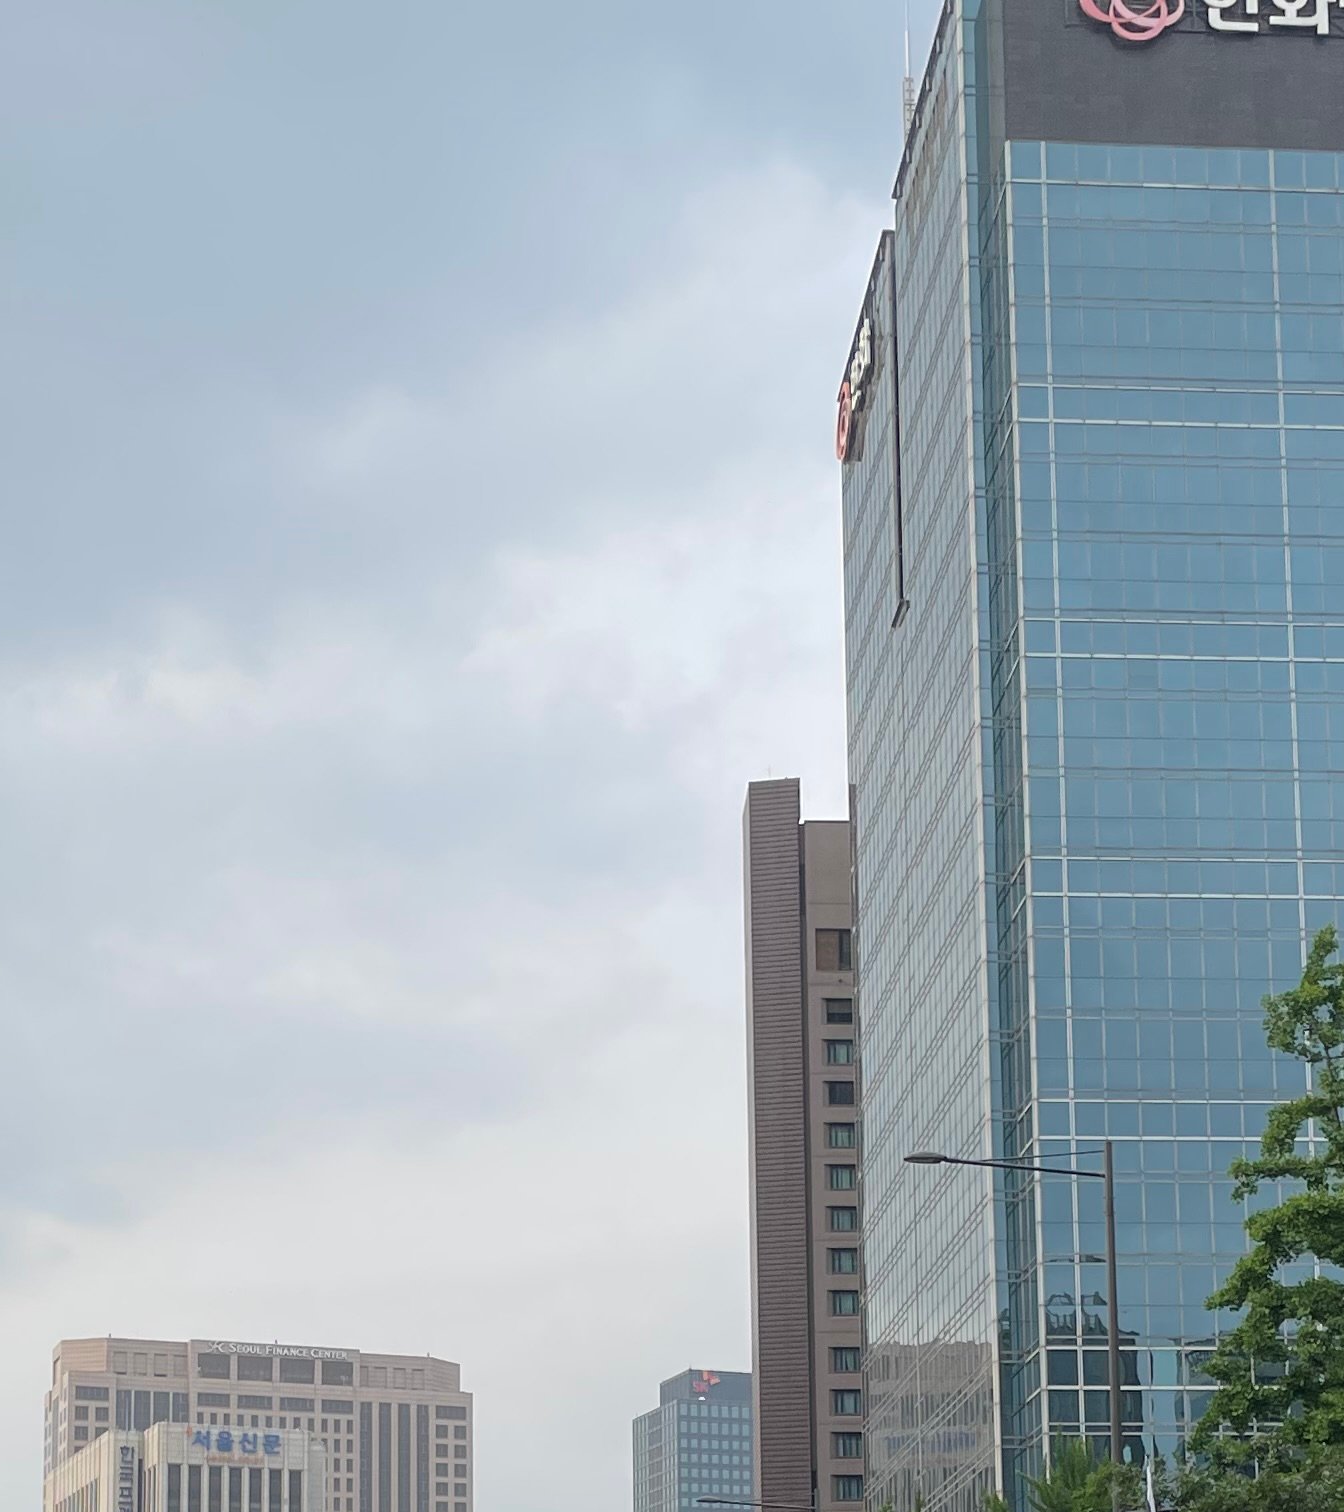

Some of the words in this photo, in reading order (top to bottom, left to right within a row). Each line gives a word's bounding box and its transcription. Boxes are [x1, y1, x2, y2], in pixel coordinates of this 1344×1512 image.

[229, 1342, 263, 1355] SEOUL
[266, 1345, 307, 1358] FINANCE
[310, 1348, 348, 1360] CENTER
[191, 1430, 282, 1455] 서울신문
